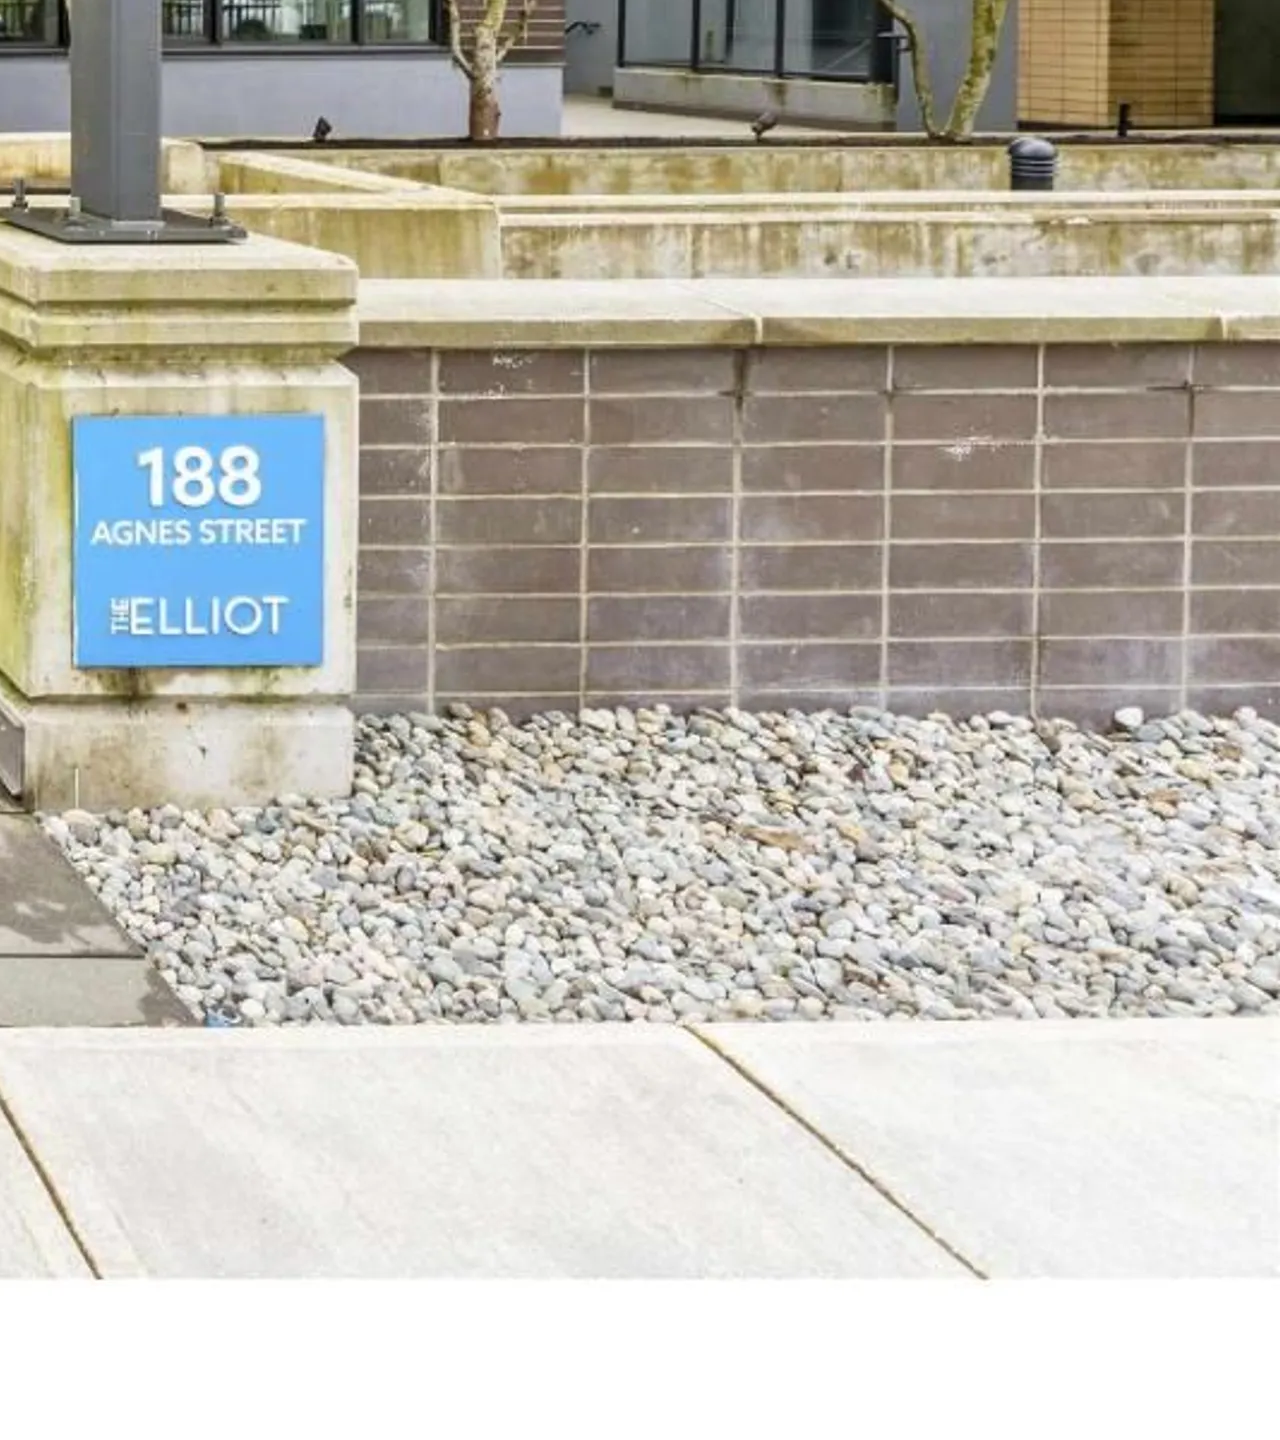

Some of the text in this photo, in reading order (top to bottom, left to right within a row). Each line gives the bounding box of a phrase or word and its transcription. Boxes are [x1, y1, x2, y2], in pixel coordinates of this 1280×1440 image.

[137, 444, 262, 508] 188
[91, 518, 307, 546] AGNES STREET
[110, 595, 289, 636] THE ELLIOT
